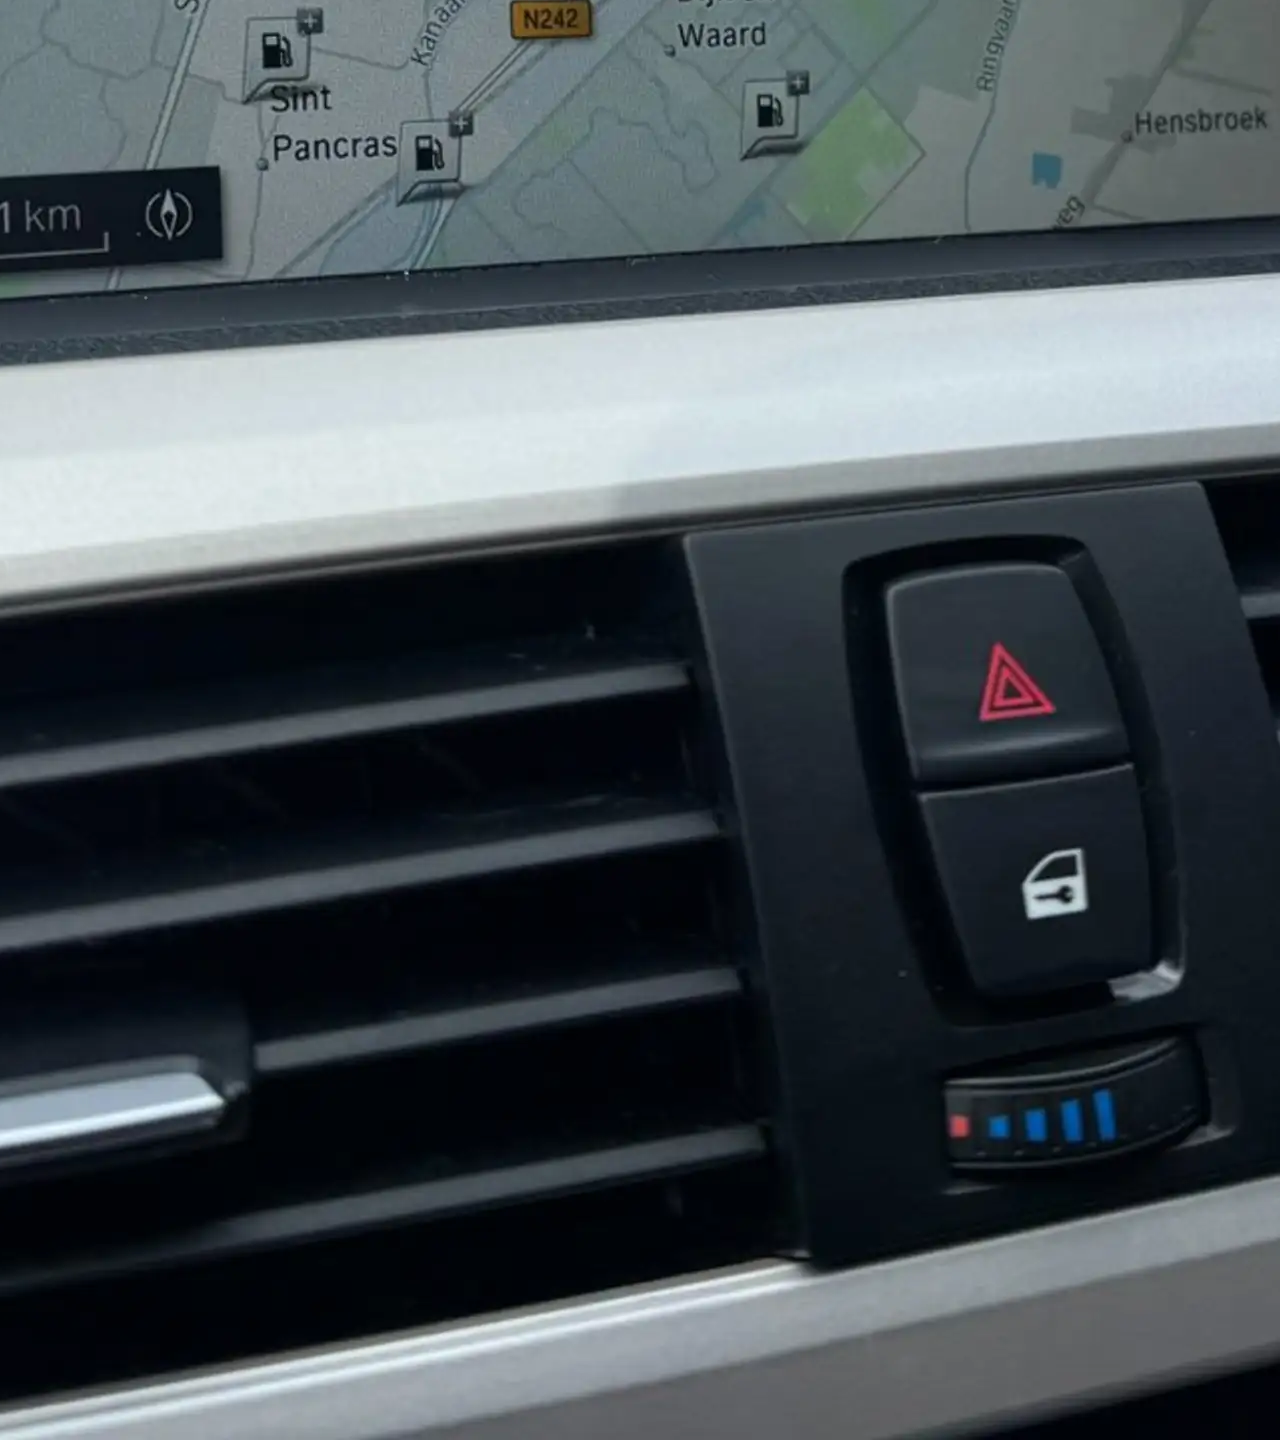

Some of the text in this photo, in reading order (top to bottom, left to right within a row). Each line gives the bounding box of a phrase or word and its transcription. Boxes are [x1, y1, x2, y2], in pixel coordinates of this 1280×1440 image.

[523, 8, 579, 31] N242
[678, 22, 767, 49] Waard
[270, 86, 332, 112] Sint
[1135, 106, 1268, 135] Hensbroek
[273, 133, 398, 161] Pancras
[25, 199, 82, 233] km
